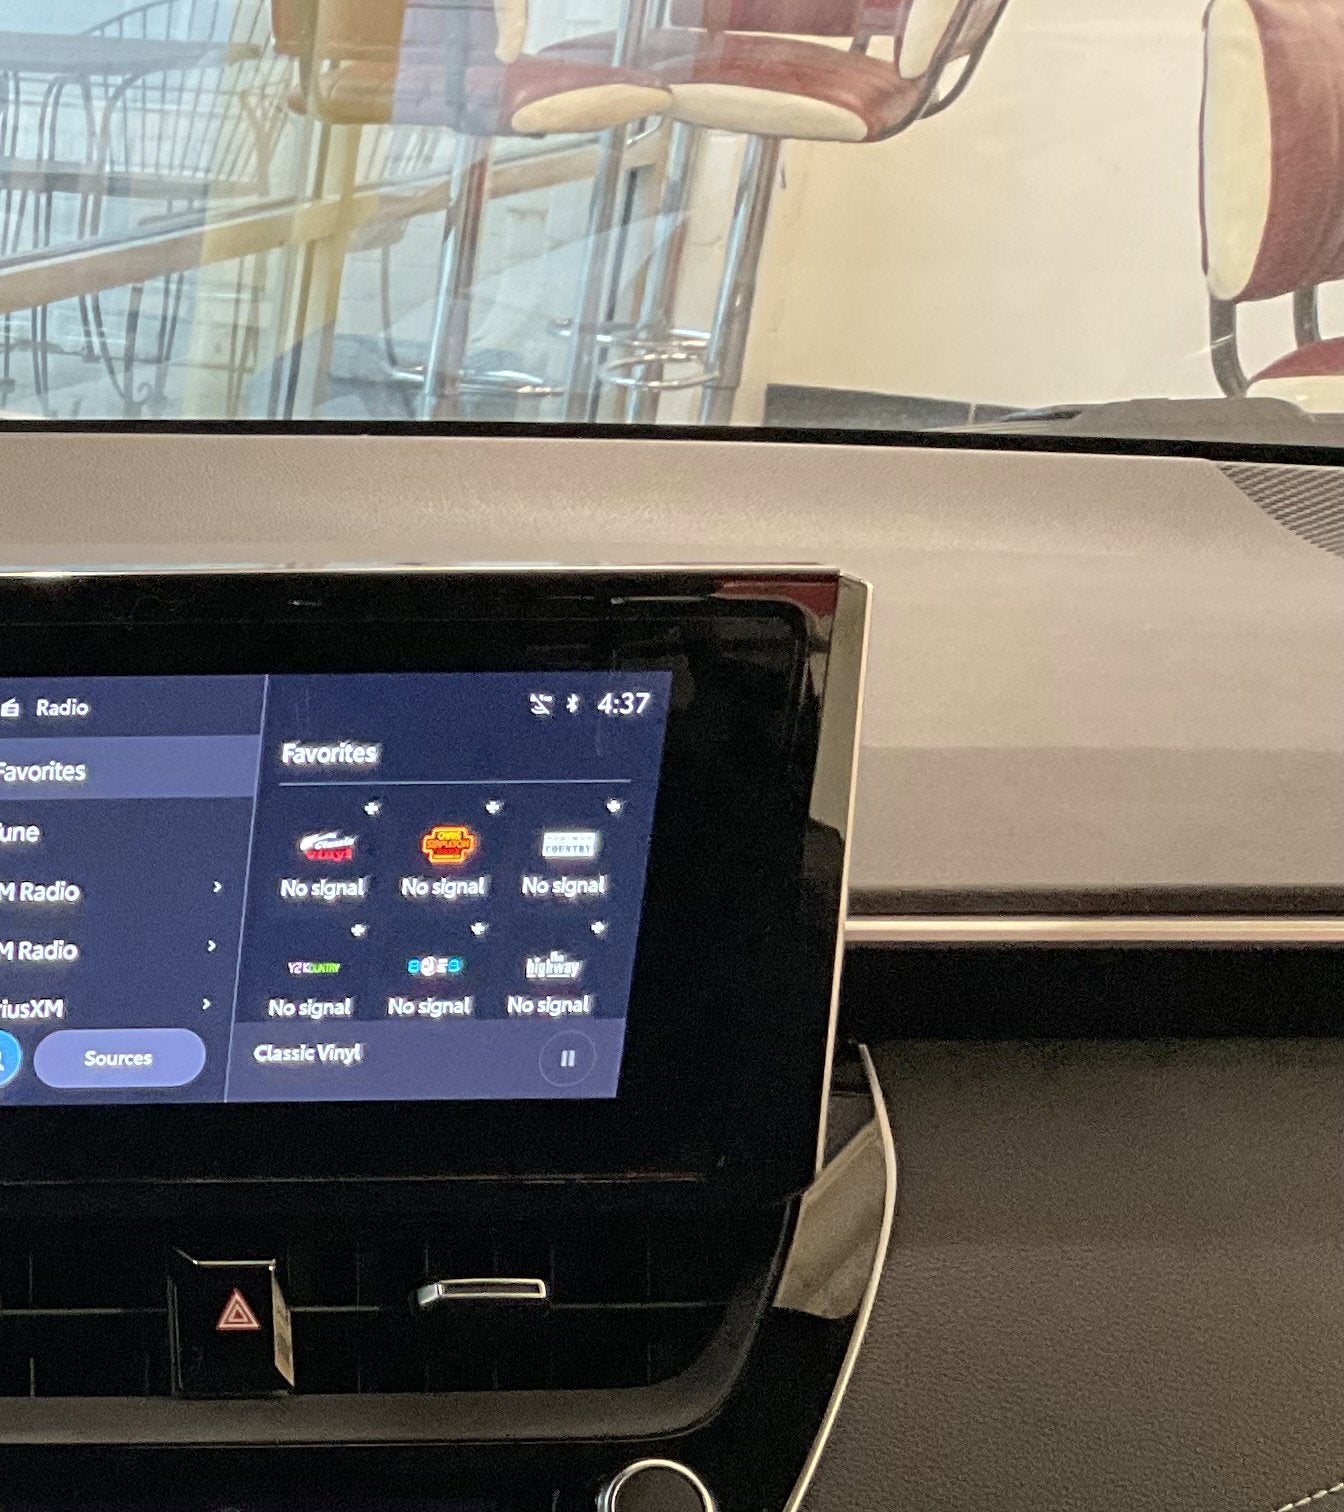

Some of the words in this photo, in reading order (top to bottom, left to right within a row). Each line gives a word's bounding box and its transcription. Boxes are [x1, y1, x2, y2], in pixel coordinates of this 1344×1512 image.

[35, 698, 90, 717] Radio
[597, 692, 651, 714] 4:37
[282, 741, 378, 765] Favorites
[19, 880, 81, 902] Radio
[280, 878, 308, 898] No
[310, 877, 366, 901] signal
[401, 877, 429, 897] No
[431, 876, 486, 900] signal
[521, 876, 550, 896] No
[551, 875, 606, 899] signal
[17, 939, 79, 961] Radio
[268, 998, 296, 1017] No
[298, 997, 352, 1020] signal
[387, 997, 415, 1016] No
[417, 996, 472, 1019] signal
[506, 995, 534, 1015] No
[536, 994, 591, 1018] signal
[83, 1049, 154, 1067] Sources
[253, 1043, 316, 1064] Classic
[316, 1042, 363, 1066] Vinyl
